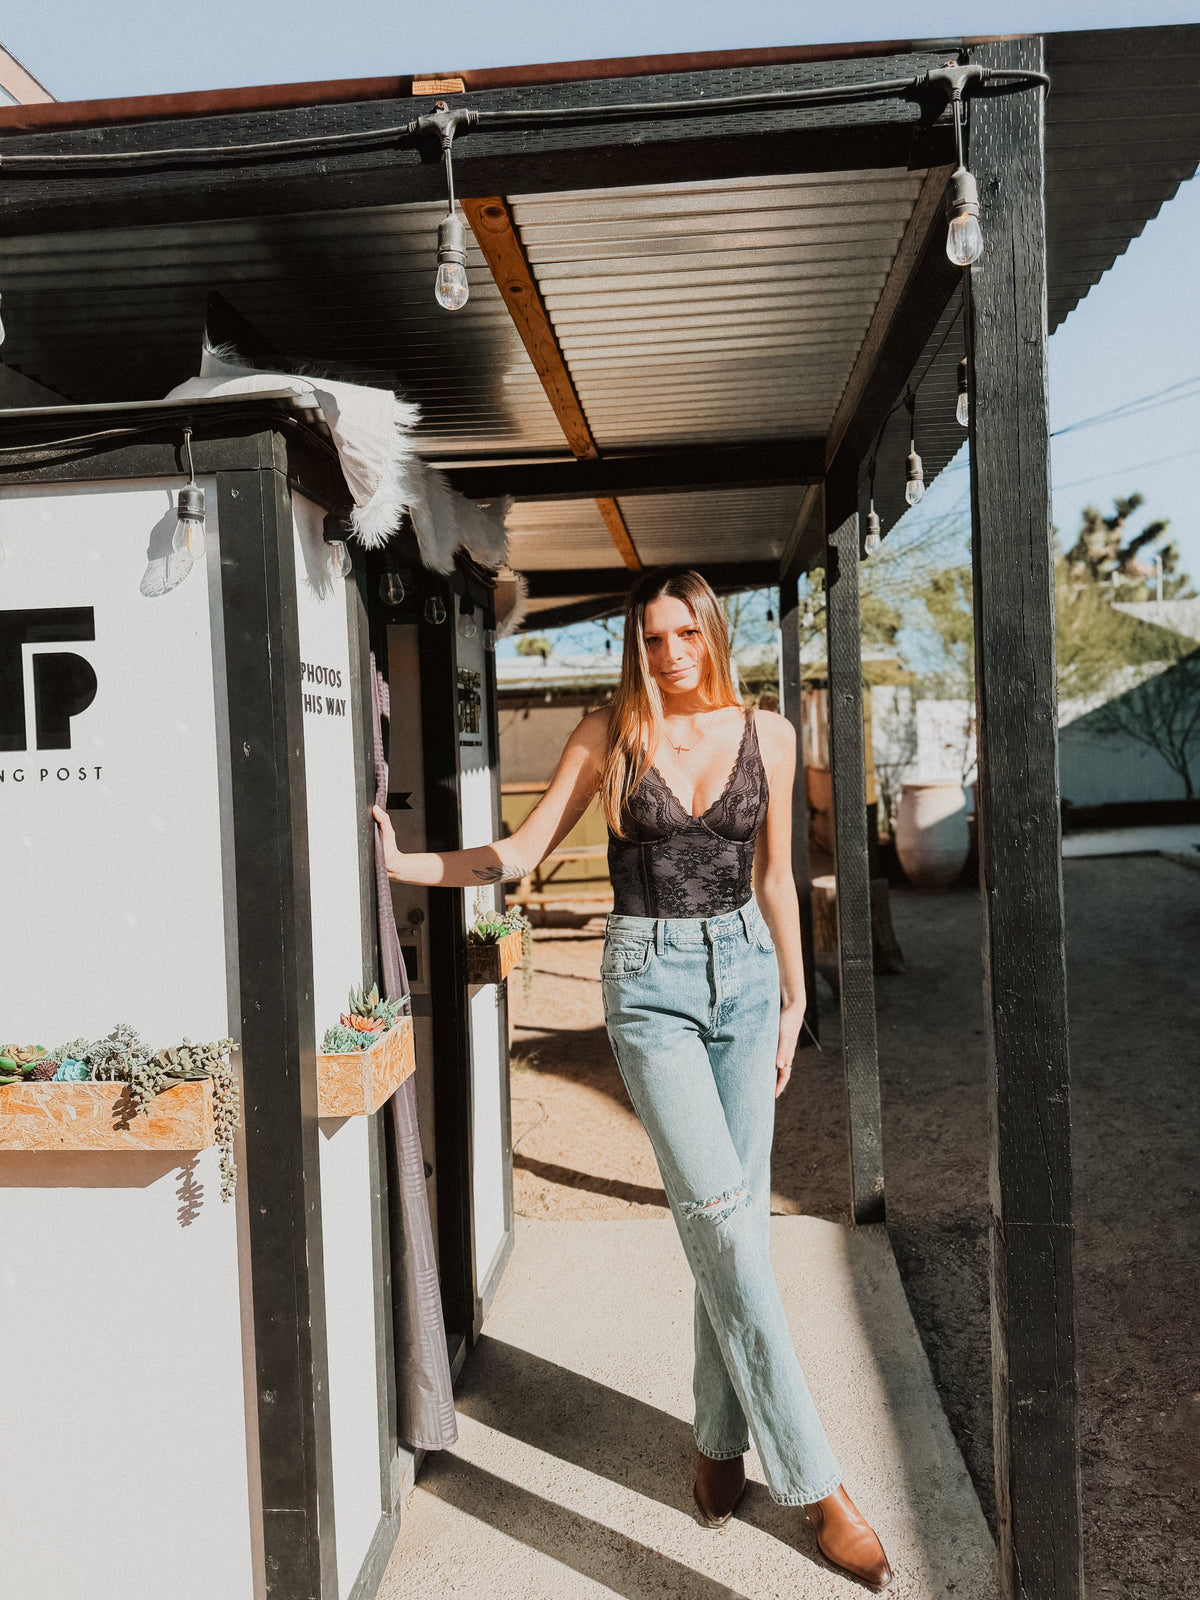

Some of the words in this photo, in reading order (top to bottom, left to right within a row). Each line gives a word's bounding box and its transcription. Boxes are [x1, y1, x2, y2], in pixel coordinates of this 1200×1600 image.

[300, 661, 342, 688] PHOTOS
[301, 693, 323, 715] HIS
[325, 697, 346, 716] WAY
[40, 767, 102, 782] POST
